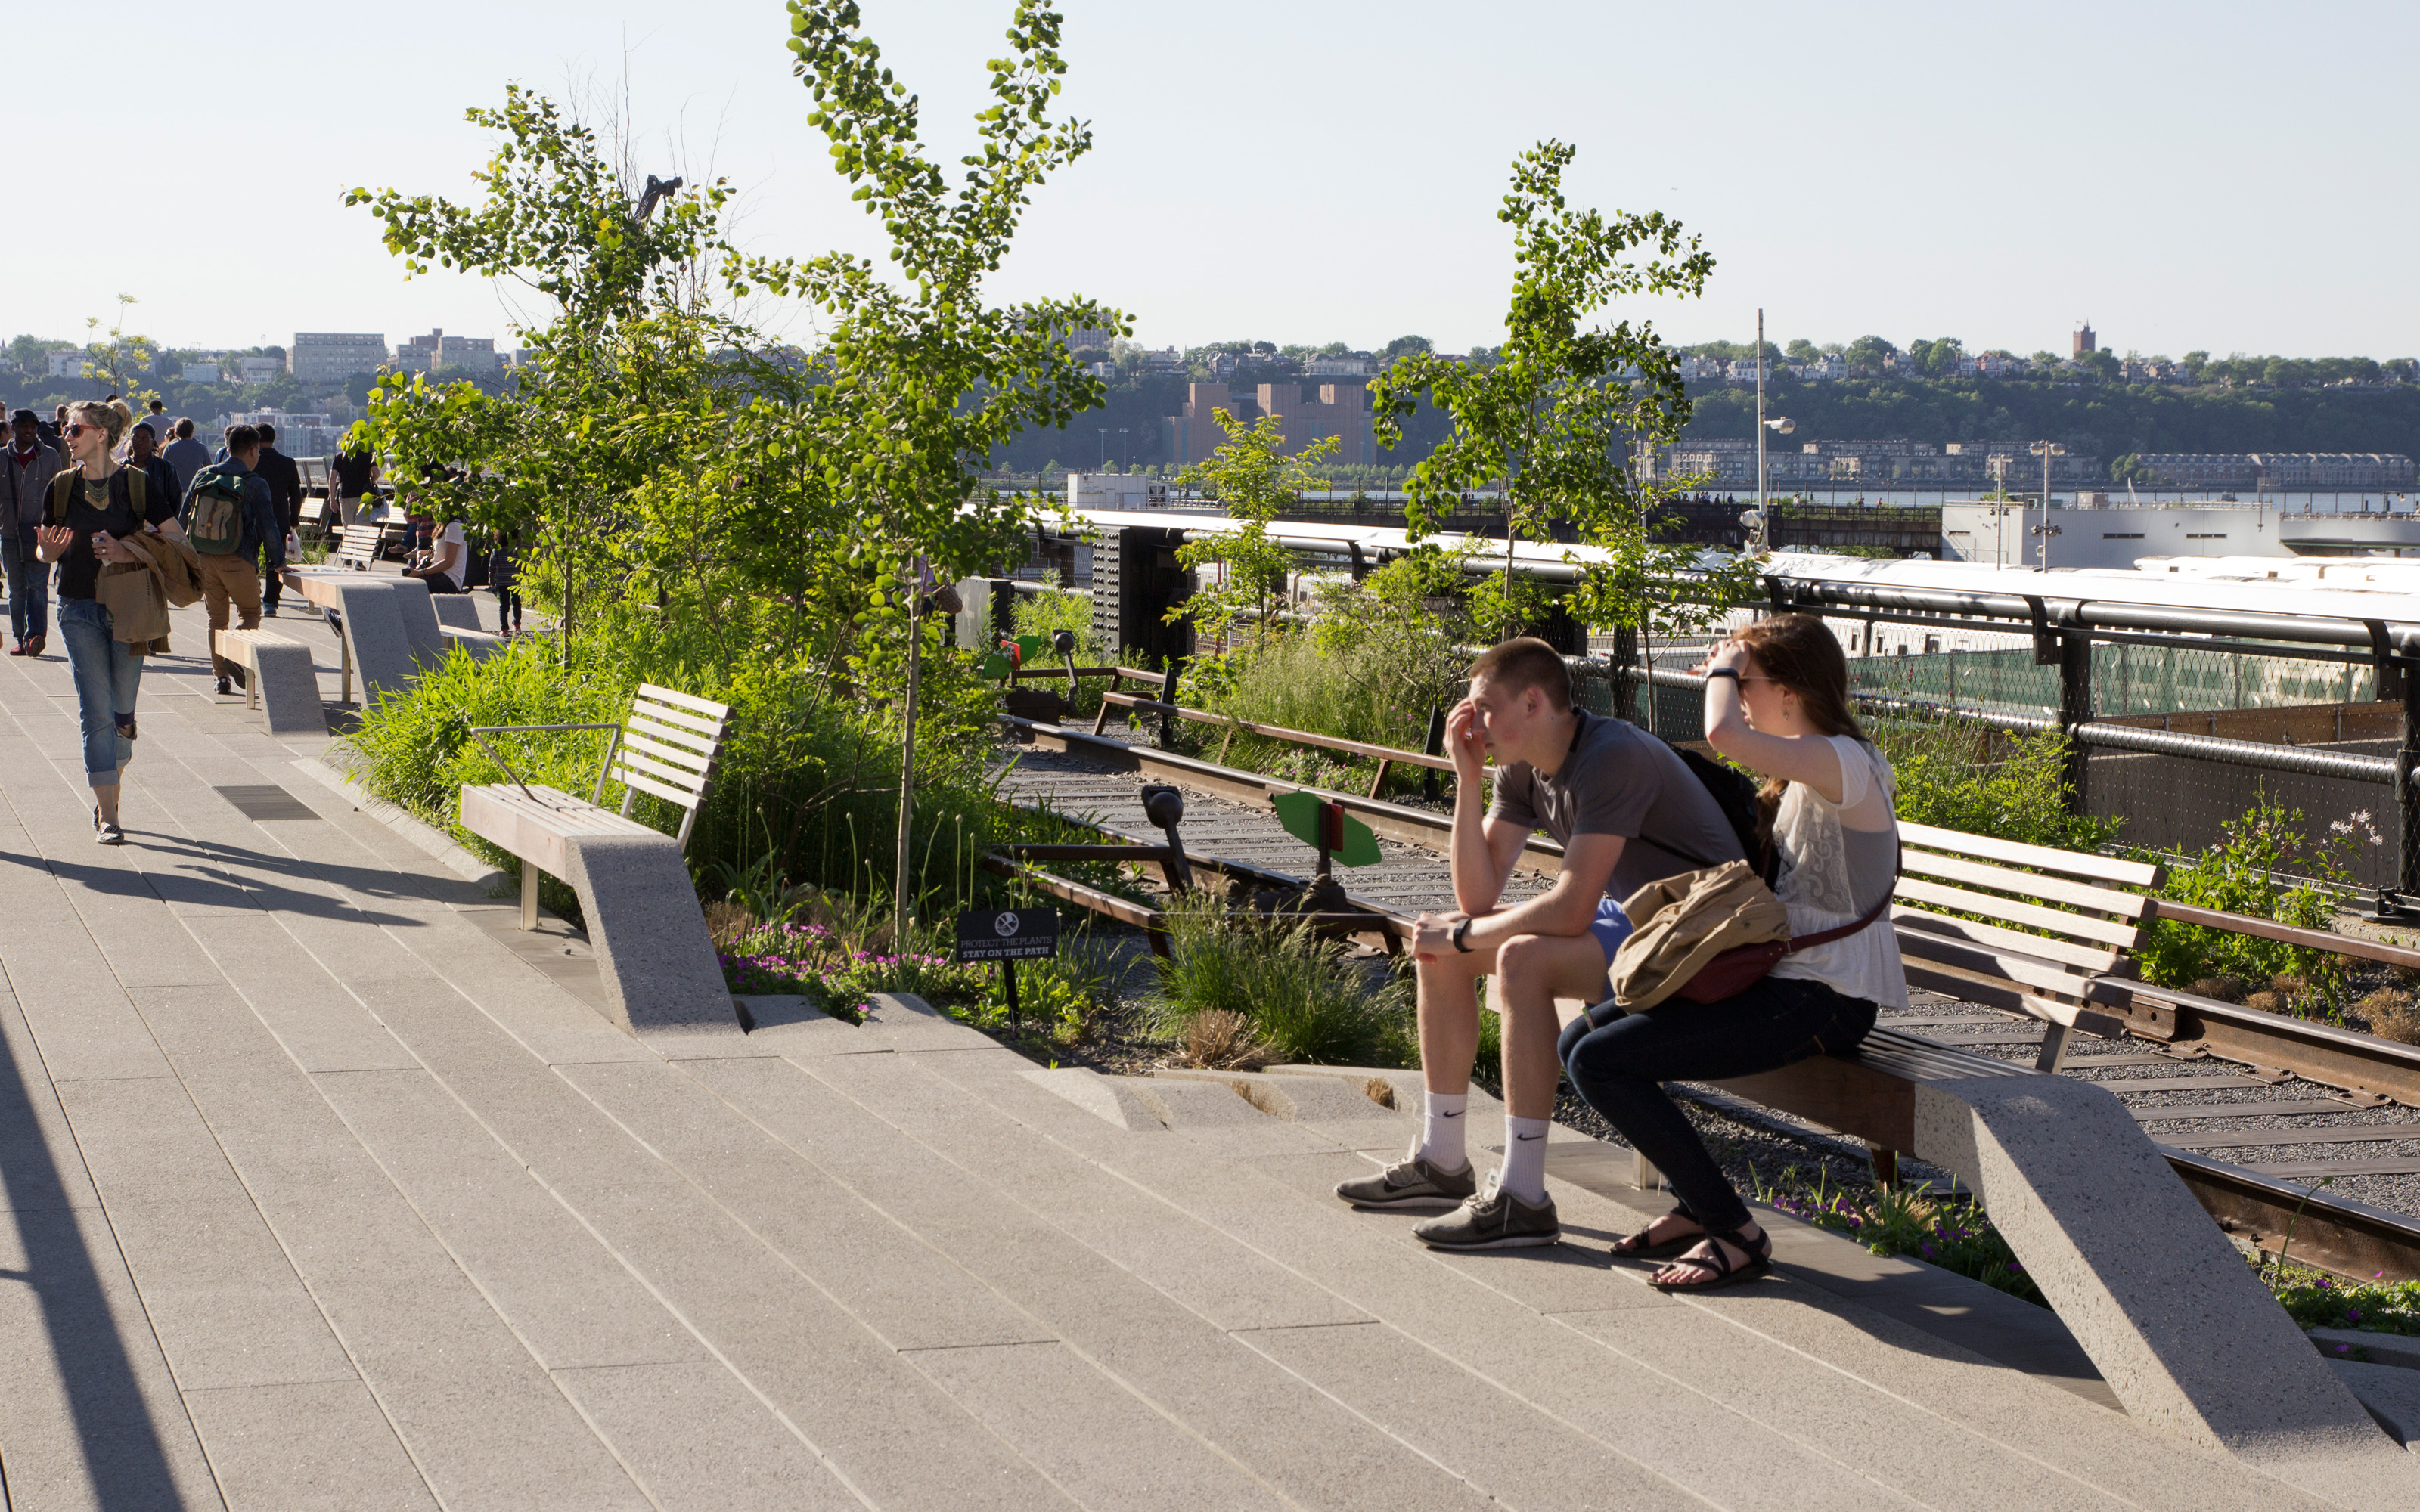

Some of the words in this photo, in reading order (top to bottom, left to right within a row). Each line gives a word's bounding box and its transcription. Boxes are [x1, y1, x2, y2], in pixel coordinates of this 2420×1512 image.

[960, 939, 1001, 948] PROTECT
[1001, 937, 1019, 946] THE
[1019, 936, 1053, 945] PLANTS
[963, 950, 985, 959] STAY
[988, 949, 1003, 957] ON
[1004, 948, 1023, 956] THE
[1025, 947, 1049, 955] PATH
